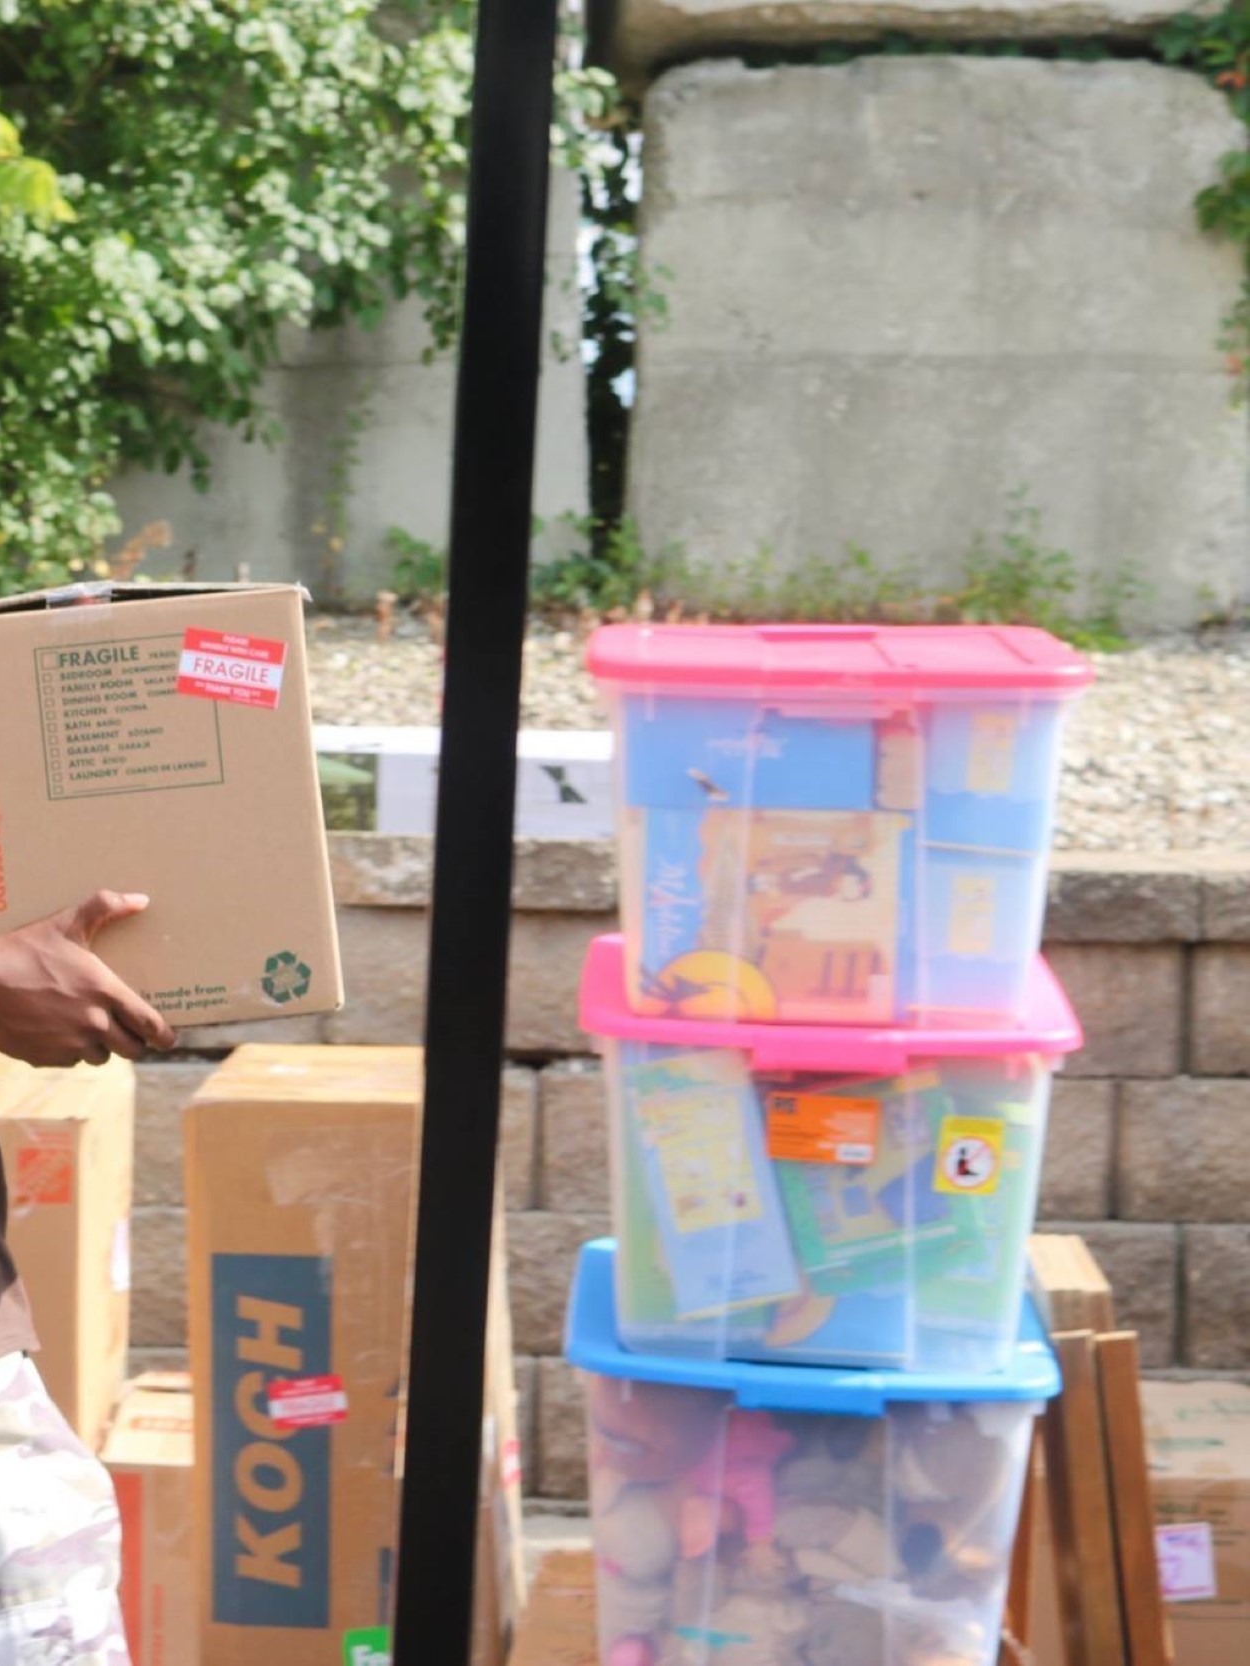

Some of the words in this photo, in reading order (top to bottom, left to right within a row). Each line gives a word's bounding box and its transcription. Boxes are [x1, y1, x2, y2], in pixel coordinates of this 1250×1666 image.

[58, 646, 139, 668] FRAGILE
[60, 668, 112, 681] BEDROOM
[194, 657, 270, 684] FRAGILE
[61, 682, 96, 693] FAMILY
[100, 679, 133, 690] ROOM
[62, 694, 101, 706] DINING
[104, 691, 137, 702] ROOM
[63, 706, 108, 718] KITCHEN
[65, 719, 91, 731] BATH
[66, 730, 119, 743] BASEMENT
[67, 743, 110, 756] GARAGE
[69, 757, 96, 769] ATTIC
[69, 768, 118, 781] LAUNDRY
[154, 986, 191, 998] made
[194, 984, 227, 995] from
[233, 1294, 306, 1589] KOCH
